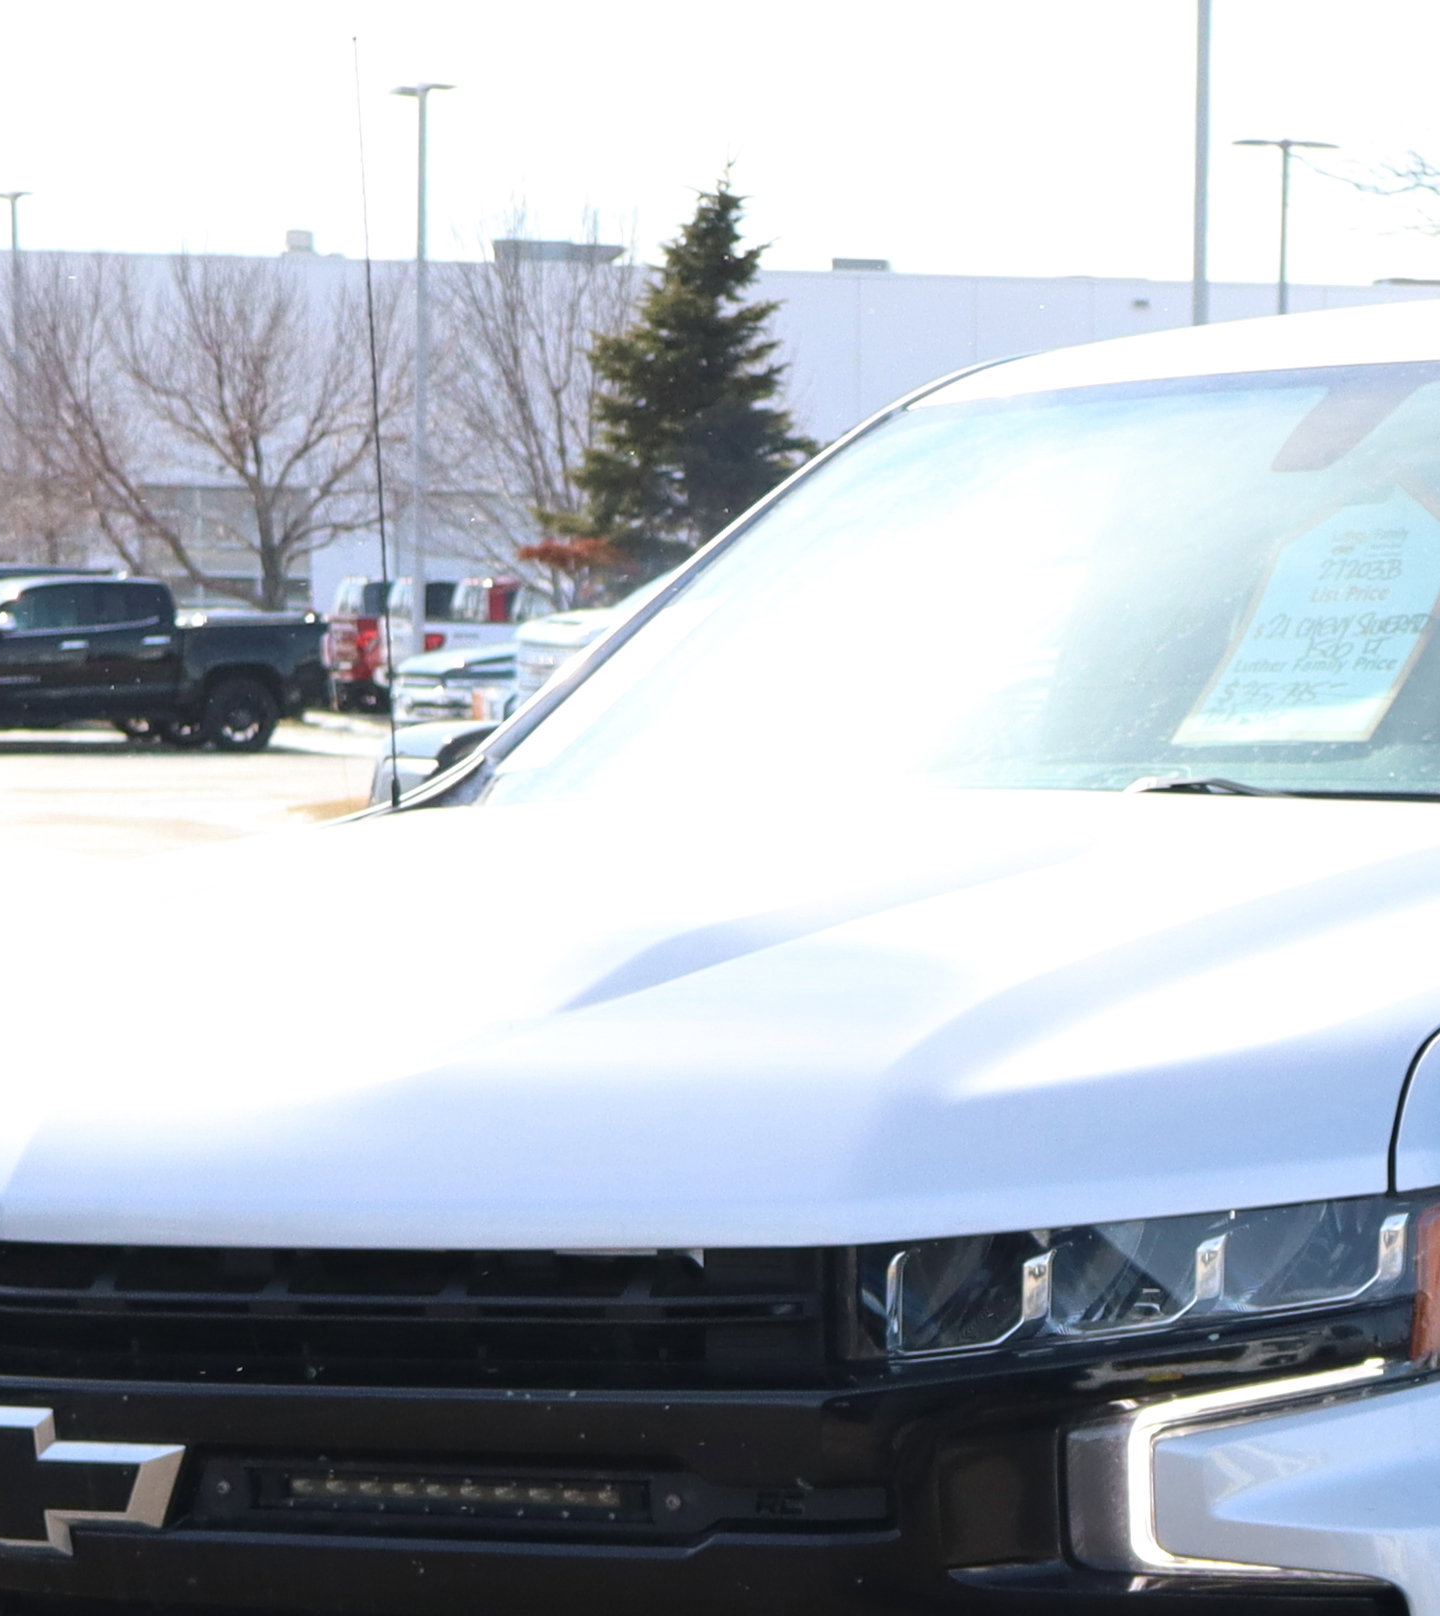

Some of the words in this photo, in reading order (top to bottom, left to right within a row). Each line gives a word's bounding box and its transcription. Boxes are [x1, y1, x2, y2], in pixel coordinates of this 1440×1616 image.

[1345, 584, 1391, 603] Price
[1233, 658, 1288, 674] Luther
[1291, 656, 1349, 674] Family
[1352, 655, 1398, 672] Price
